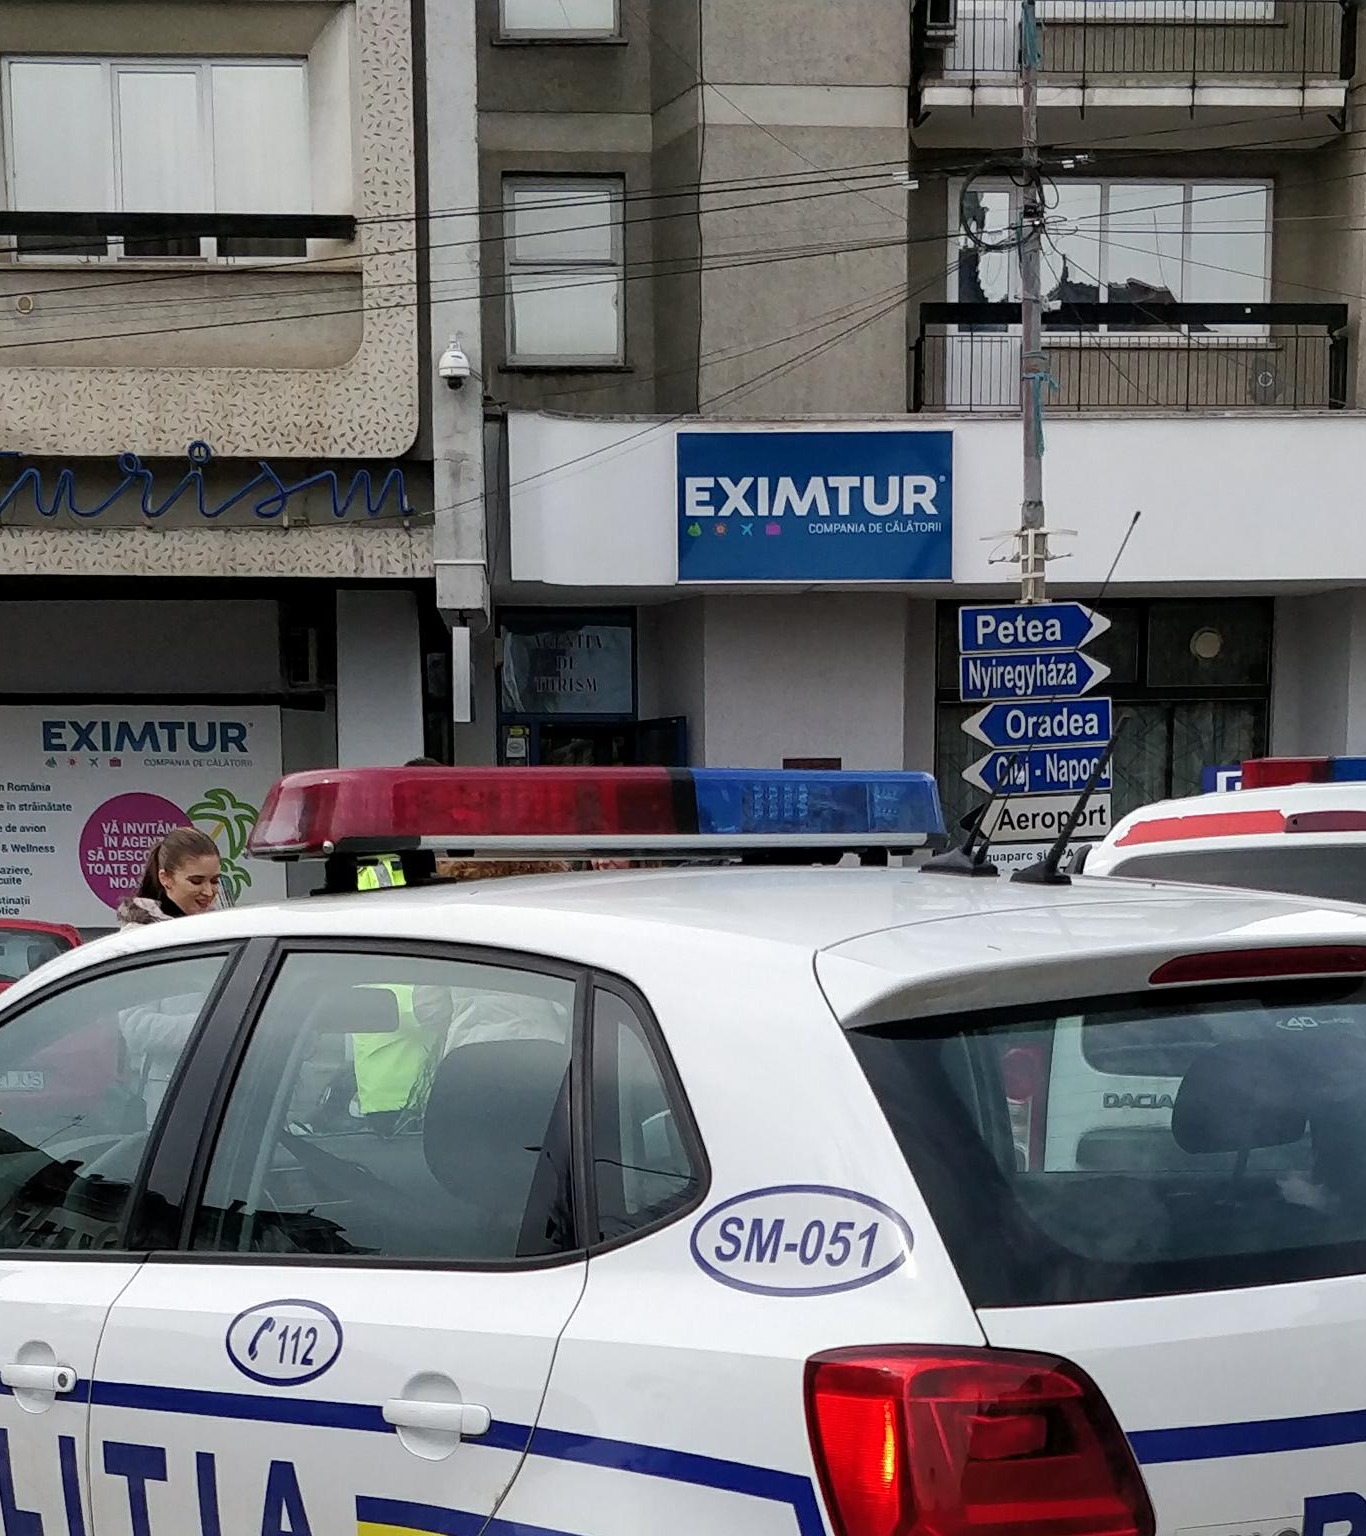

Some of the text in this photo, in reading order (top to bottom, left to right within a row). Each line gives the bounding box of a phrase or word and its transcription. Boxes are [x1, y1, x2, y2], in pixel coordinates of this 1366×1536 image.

[684, 475, 939, 517] EXIMTUR
[808, 519, 942, 535] COMPANIA DE CĂLĂTORII
[976, 614, 1061, 645] Petea
[968, 656, 1077, 699] Nyiregyháza
[1005, 708, 1099, 739] Oradea
[42, 720, 249, 752] EXIMTUR
[143, 758, 191, 767] COMPANIA
[193, 758, 204, 767] DE
[7, 782, 51, 792] România
[101, 819, 177, 834] VĂ INVITĂM
[997, 804, 1106, 834] Aeroport
[5, 822, 17, 833] de
[19, 824, 46, 833] avion
[1, 843, 9, 853] &
[10, 843, 55, 854] Wellness
[104, 833, 119, 848] ÎN
[87, 847, 106, 862] SĂ
[87, 863, 128, 875] TOATE
[1102, 1092, 1174, 1109] DACIA
[713, 1216, 880, 1268] SM-051
[278, 1324, 318, 1366] 112
